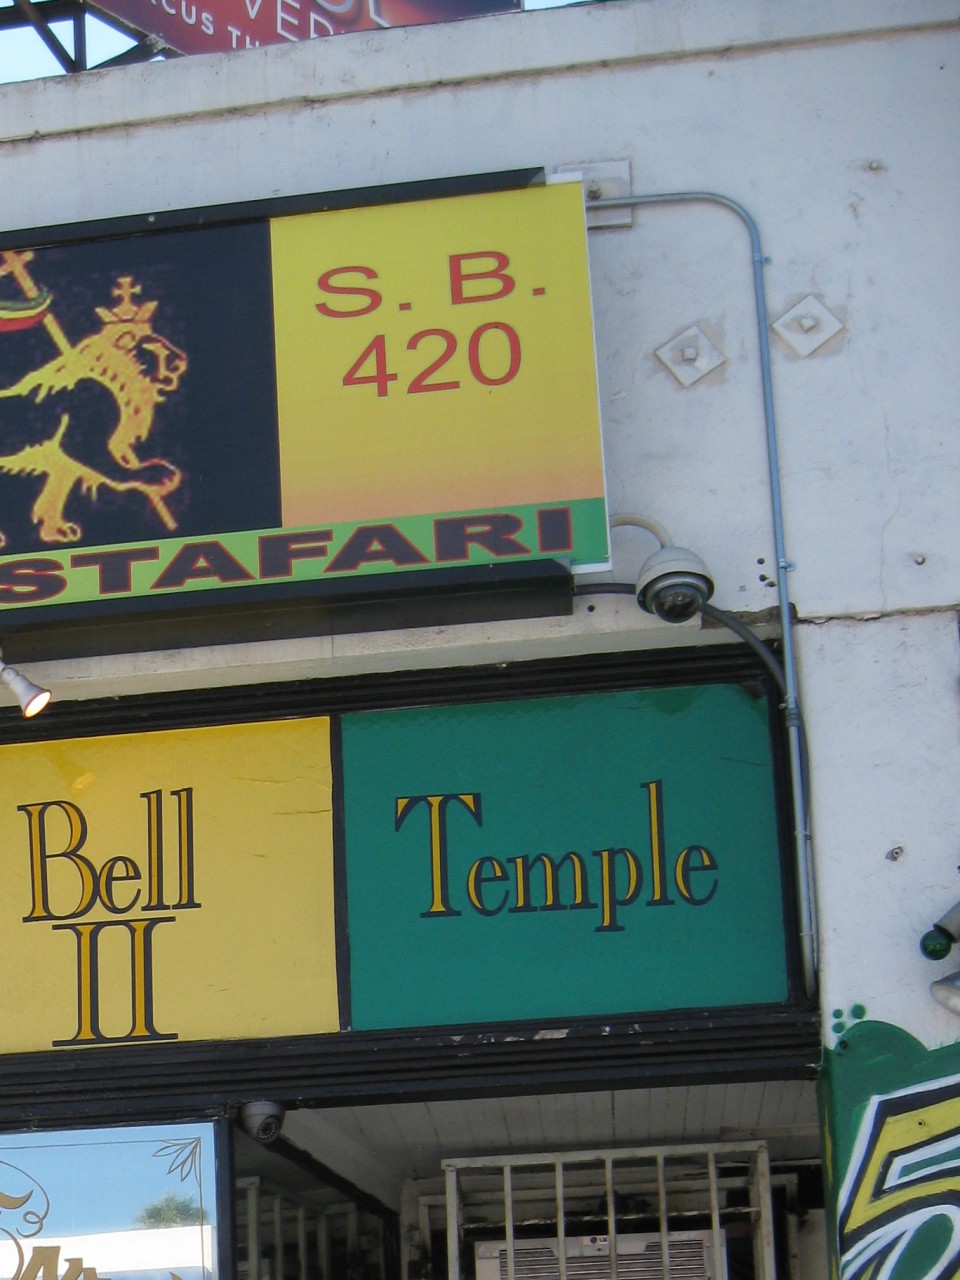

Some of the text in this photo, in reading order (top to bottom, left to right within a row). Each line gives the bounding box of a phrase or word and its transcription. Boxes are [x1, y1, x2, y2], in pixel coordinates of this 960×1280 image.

[315, 250, 547, 319] S. B.
[342, 321, 523, 398] 420
[17, 786, 202, 923] Bell
[394, 779, 719, 933] Temple
[51, 916, 179, 1048] II
